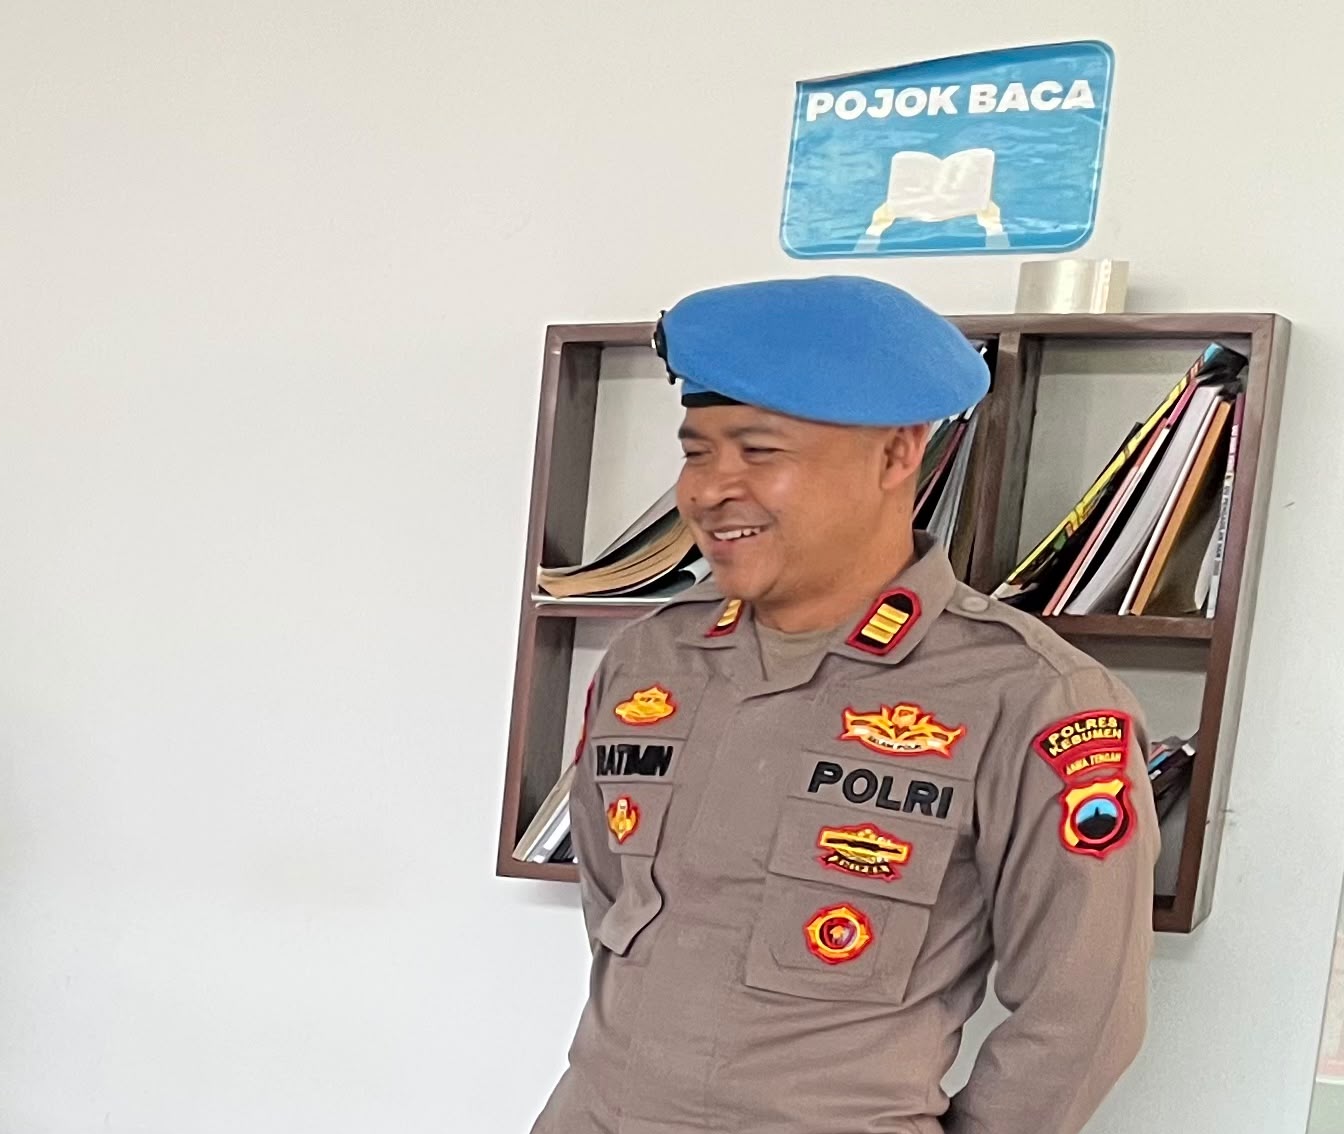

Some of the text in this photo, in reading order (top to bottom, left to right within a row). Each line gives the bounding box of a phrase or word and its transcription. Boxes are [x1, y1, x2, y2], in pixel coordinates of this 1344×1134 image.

[805, 79, 1096, 121] POJOK BACA
[1048, 716, 1118, 746] POLRES
[1049, 728, 1122, 757] KEBUMEN
[807, 761, 954, 820] POLRI
